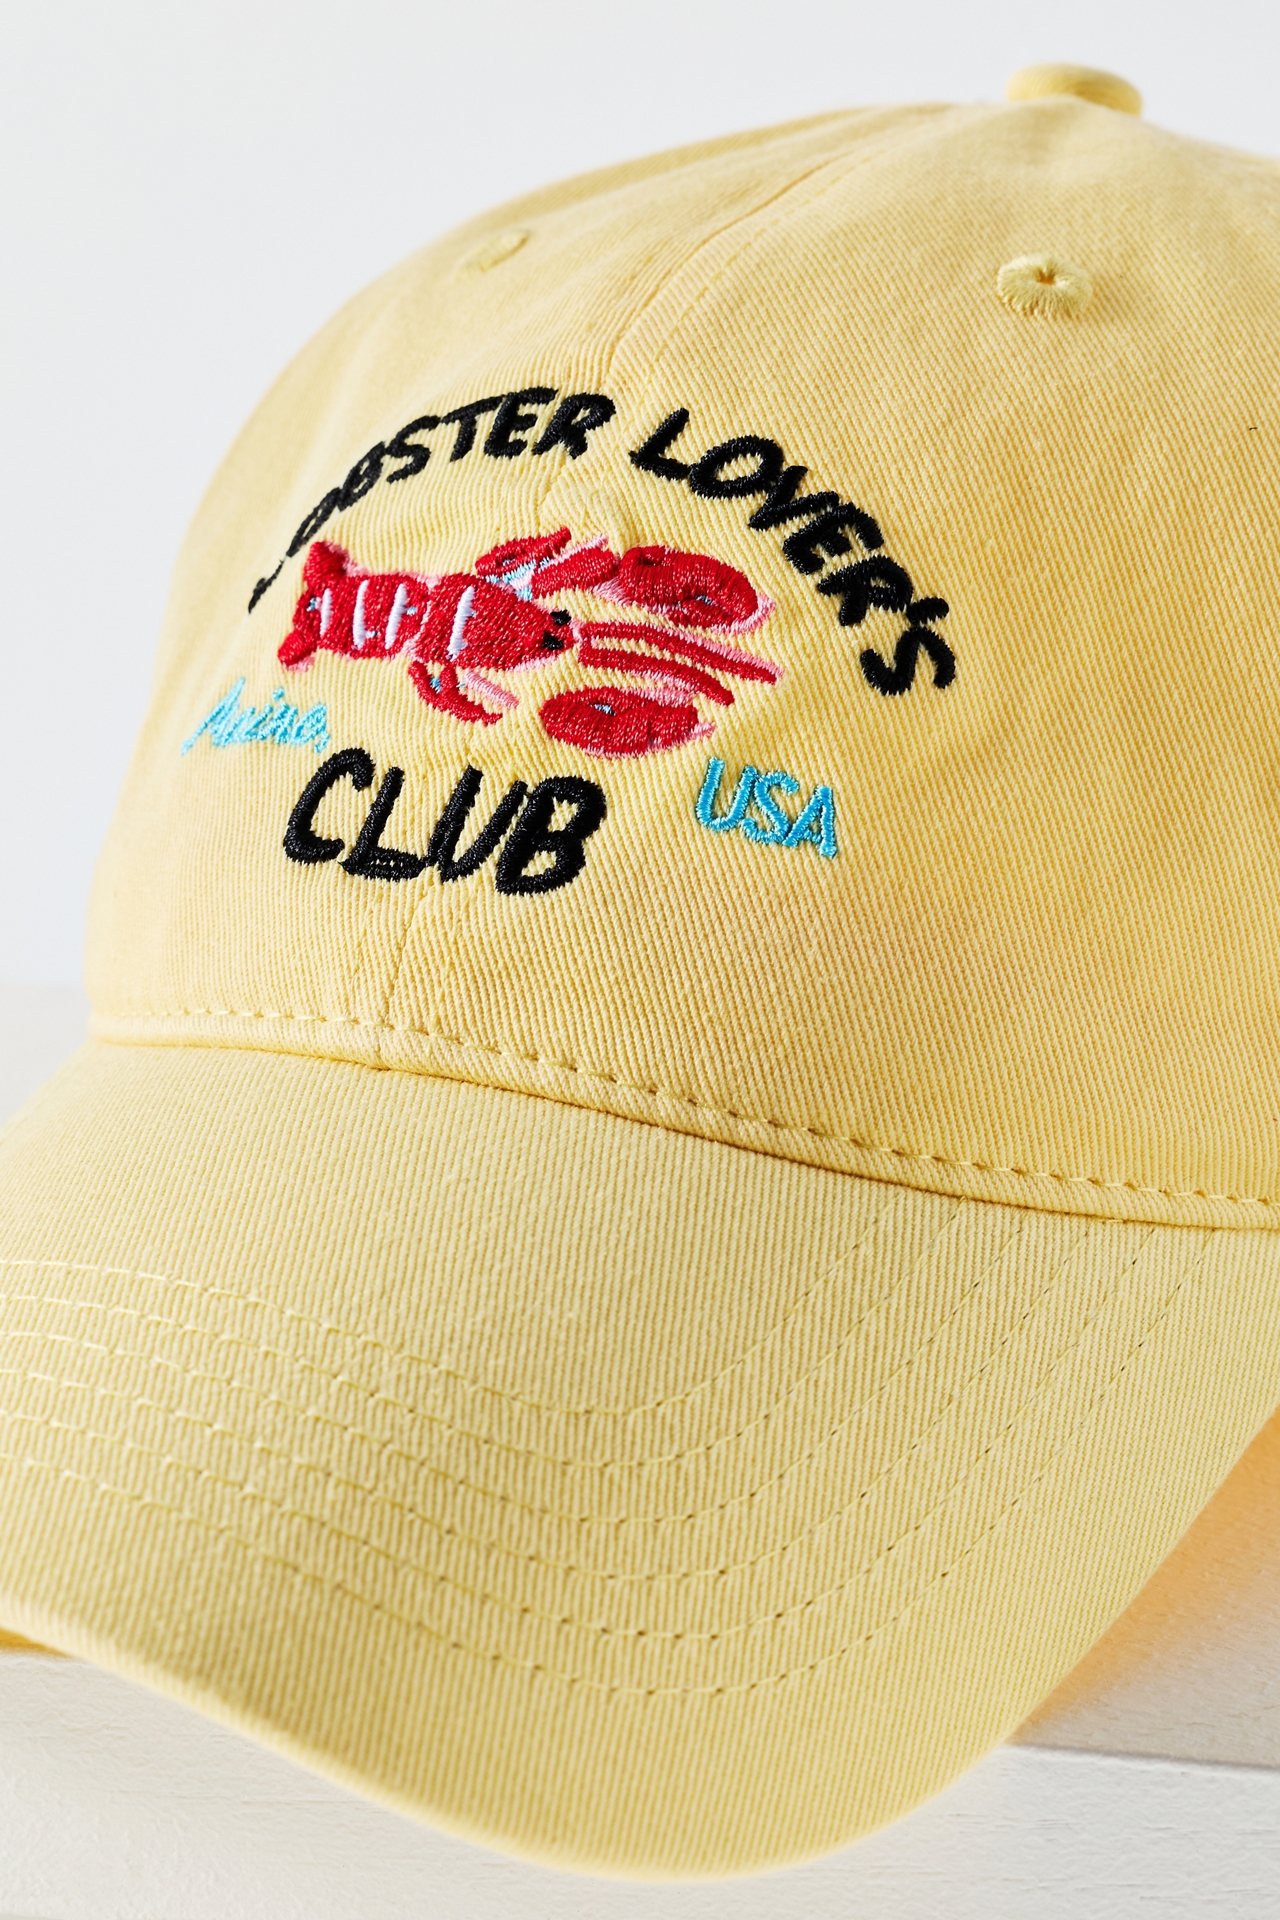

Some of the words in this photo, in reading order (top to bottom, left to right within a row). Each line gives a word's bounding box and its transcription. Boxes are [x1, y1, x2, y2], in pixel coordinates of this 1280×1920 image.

[629, 408, 956, 697] LOVER'S
[283, 747, 607, 897] CLUB
[695, 757, 838, 859] USA
